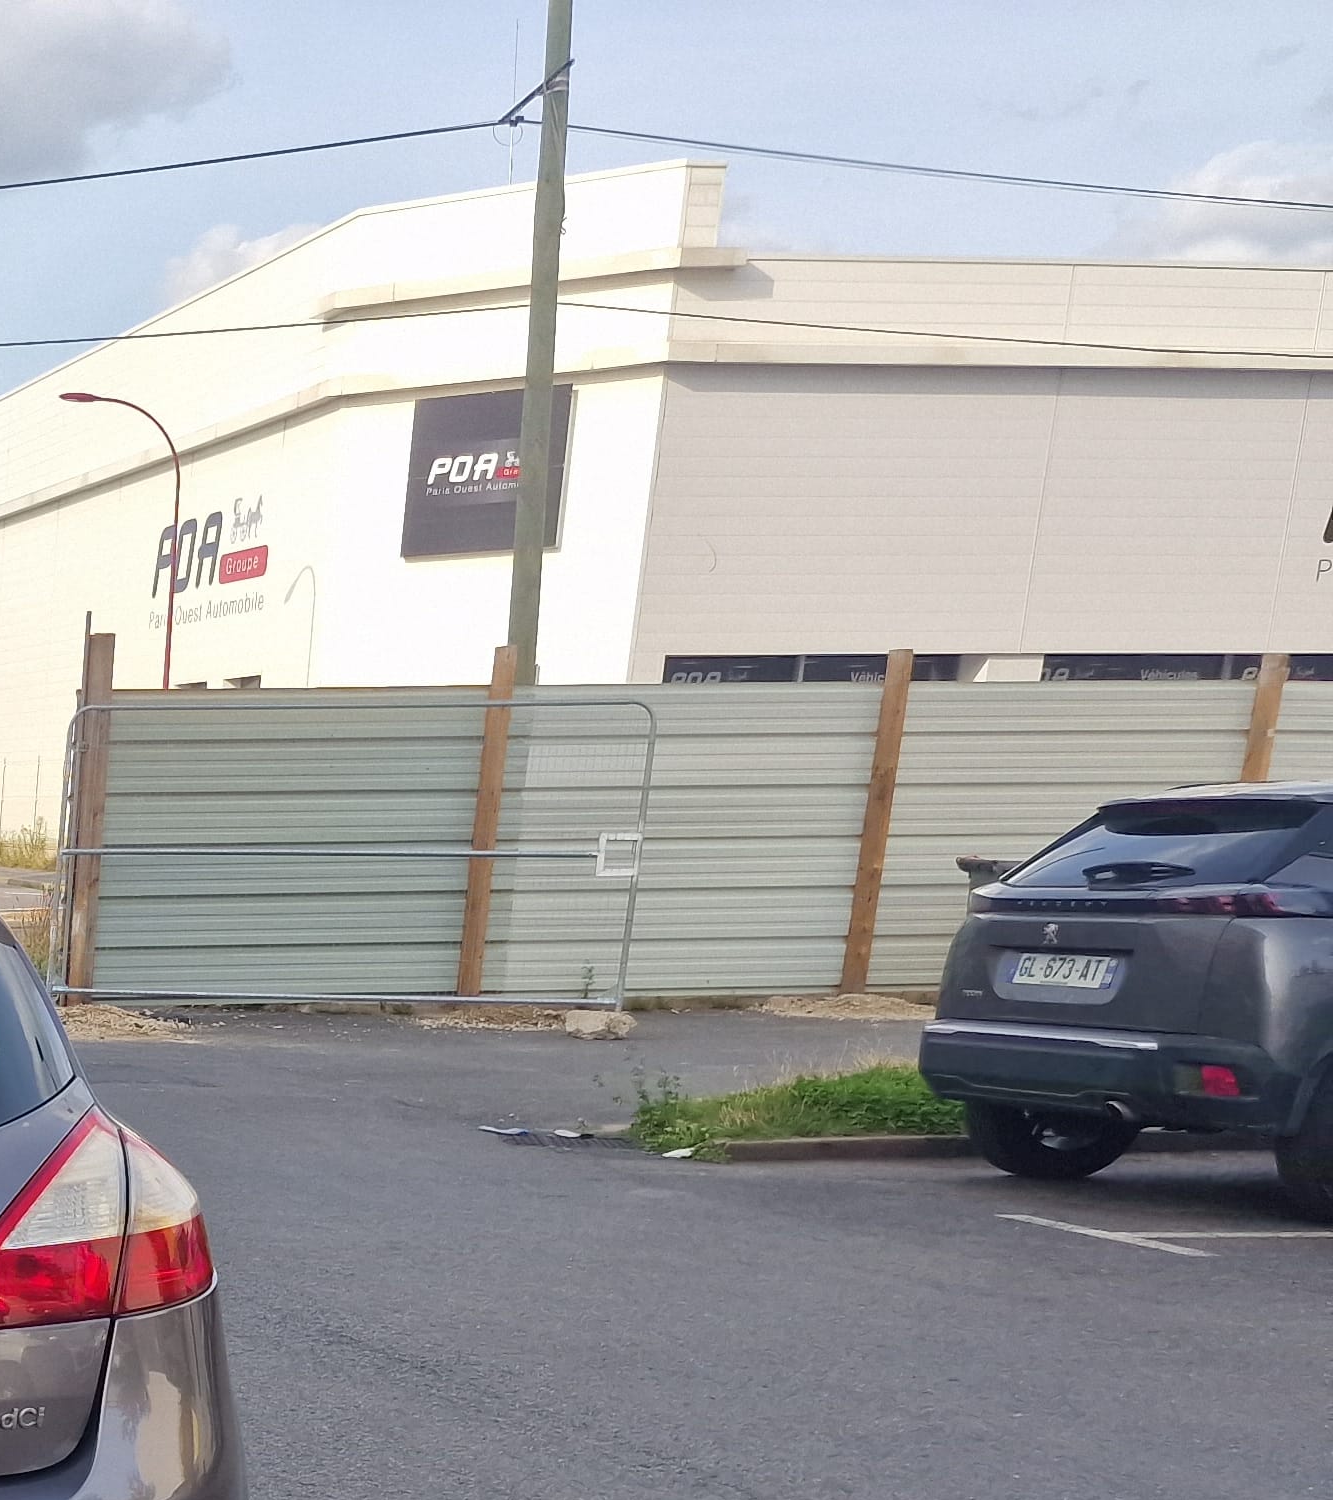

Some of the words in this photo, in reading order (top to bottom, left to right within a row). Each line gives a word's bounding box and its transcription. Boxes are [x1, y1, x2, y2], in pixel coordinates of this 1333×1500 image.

[225, 554, 259, 576] Groupe
[148, 610, 171, 630] Pari
[205, 591, 265, 620] Automobile
[1018, 956, 1106, 983] GL-673-AT
